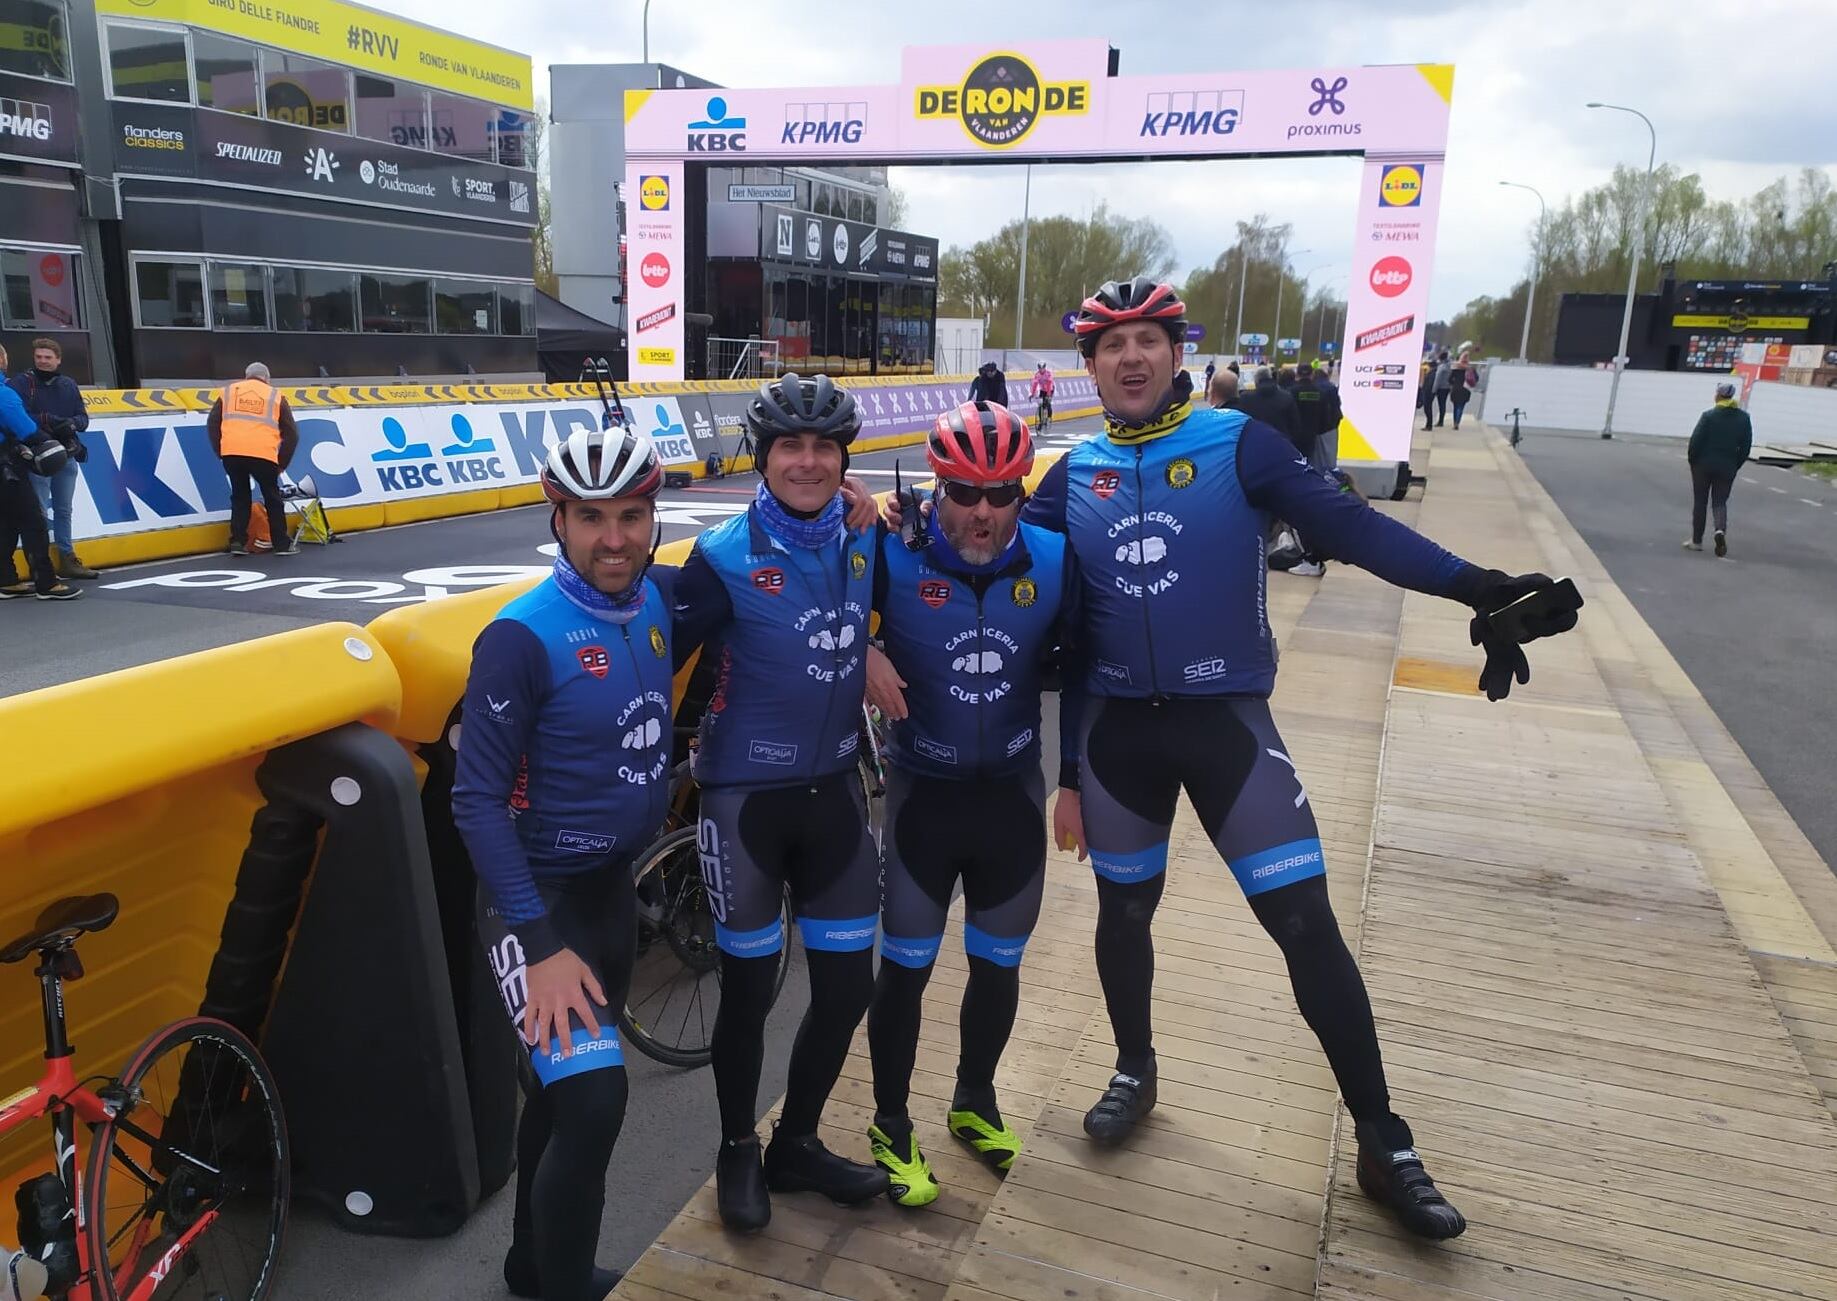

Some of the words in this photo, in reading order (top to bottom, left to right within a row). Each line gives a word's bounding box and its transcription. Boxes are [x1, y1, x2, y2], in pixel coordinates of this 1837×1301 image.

[239, 2, 273, 20] DELLE
[275, 11, 320, 34] FIANDRE
[347, 25, 399, 60] #RVV
[419, 52, 449, 71] RONDE
[450, 64, 468, 76] VAN
[469, 67, 521, 91] VLAANDEREN
[920, 90, 958, 115] DE
[966, 87, 1035, 115] RON
[1044, 86, 1085, 111] DE
[124, 125, 183, 141] flanders
[781, 120, 863, 144] KPMG
[970, 116, 1029, 141] VLAANDEREN
[989, 118, 1009, 128] VAN
[1140, 109, 1239, 137] KPMG
[1287, 123, 1362, 140] proximus
[125, 137, 184, 150] classics
[216, 142, 282, 165] SPECIALIZED
[688, 133, 746, 151] KBC
[378, 160, 398, 176] Stad
[378, 176, 436, 197] Oudenaarde
[732, 188, 745, 198] Het
[747, 188, 791, 199] Nieuwsblad
[642, 263, 668, 277] lotto
[1372, 269, 1409, 285] lotto
[1355, 365, 1373, 373] UCI
[1353, 380, 1371, 388] UCI
[695, 427, 714, 440] KBC
[655, 438, 693, 459] KBC
[377, 463, 444, 492] KBC
[446, 457, 505, 484] KBC
[1107, 511, 1183, 538] CARNICERIA
[1115, 570, 1180, 598] CUEVAS
[945, 627, 1019, 655] CARNICERIA
[806, 655, 859, 683] CUEVAS
[1183, 658, 1226, 680] SER
[949, 680, 1012, 704] CUEVAS
[617, 752, 668, 785] CUEVAS
[722, 841, 735, 912] CADENA
[1252, 851, 1320, 880] RIBERBIKE
